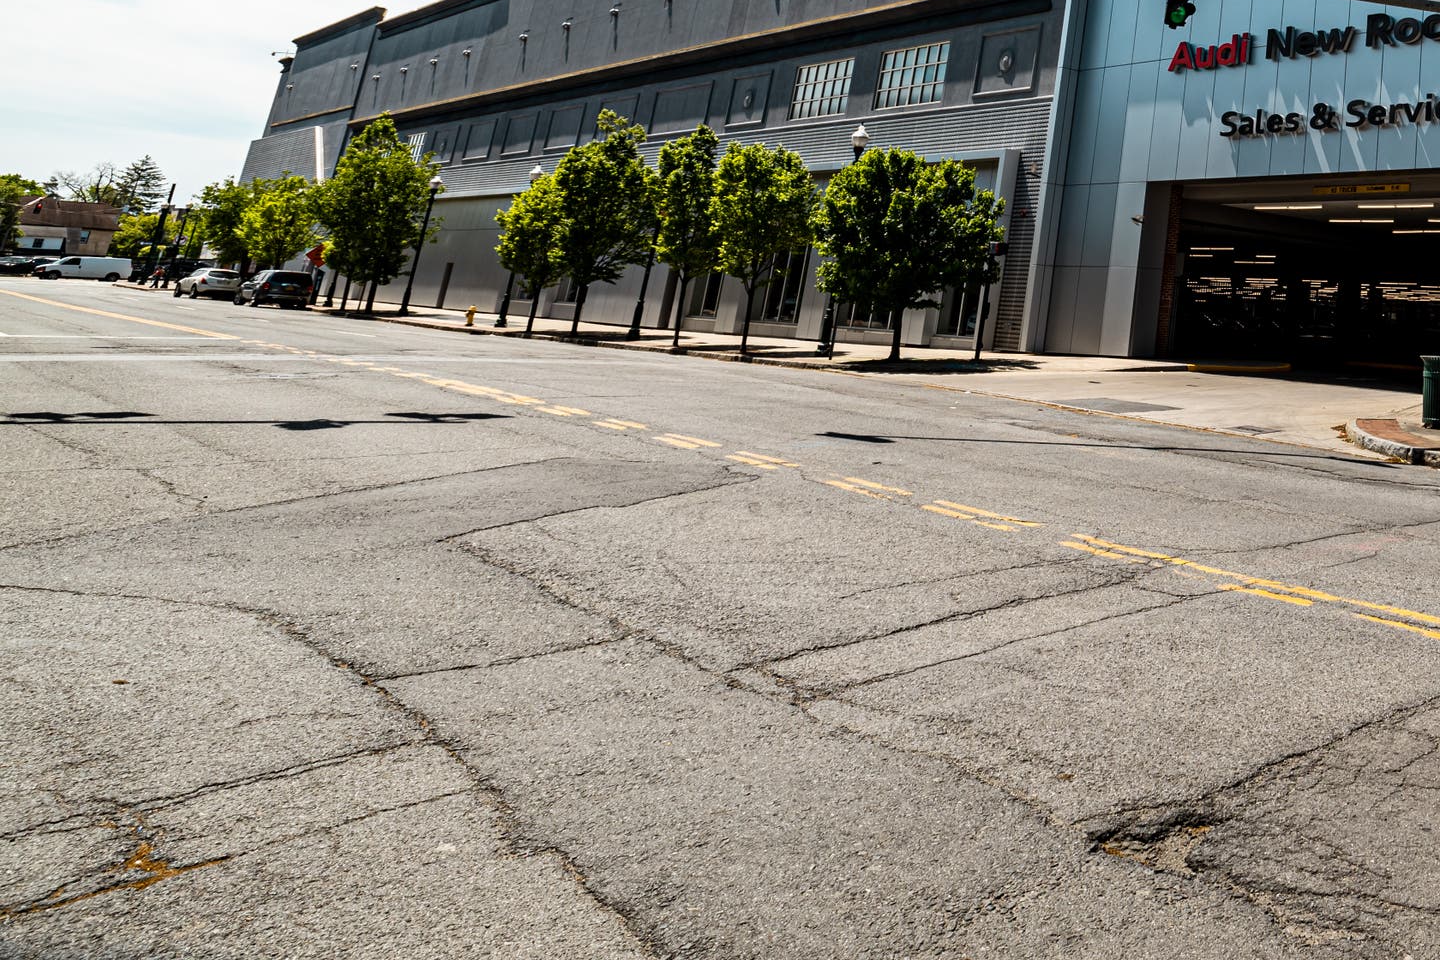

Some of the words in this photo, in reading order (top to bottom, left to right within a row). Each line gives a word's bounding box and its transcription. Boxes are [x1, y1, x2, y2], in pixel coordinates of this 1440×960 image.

[1168, 33, 1249, 72] Audi
[1265, 26, 1356, 61] New
[1220, 109, 1302, 137] Sales
[1310, 102, 1338, 130] &
